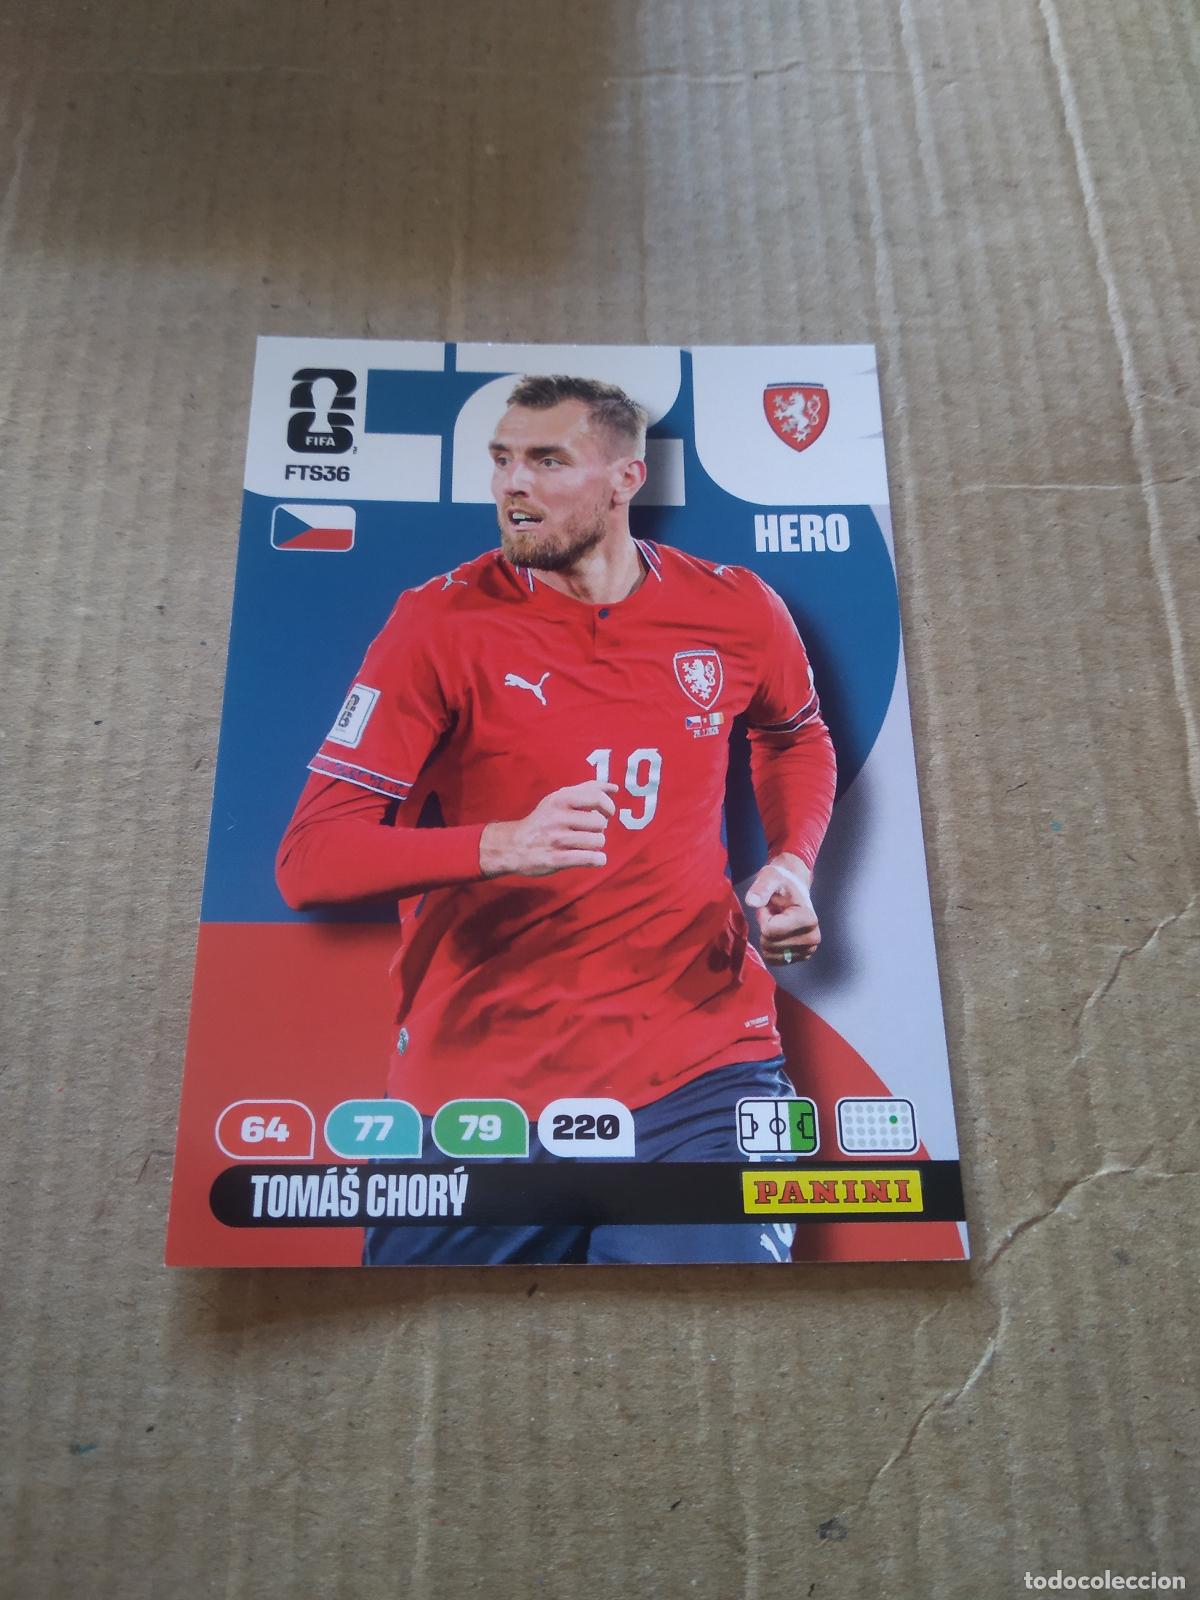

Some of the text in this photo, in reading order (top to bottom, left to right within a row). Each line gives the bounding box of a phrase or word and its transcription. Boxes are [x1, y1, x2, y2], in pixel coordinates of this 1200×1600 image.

[305, 436, 335, 447] FIFA
[285, 465, 350, 482] FTS36
[754, 513, 850, 552] HERO
[241, 1116, 290, 1143] 64
[353, 1115, 394, 1142] 77
[458, 1115, 502, 1141] 79
[552, 1114, 620, 1140] 220
[251, 1165, 469, 1218] TOMÁŠ CHORÝ
[754, 1179, 912, 1204] PANINI
